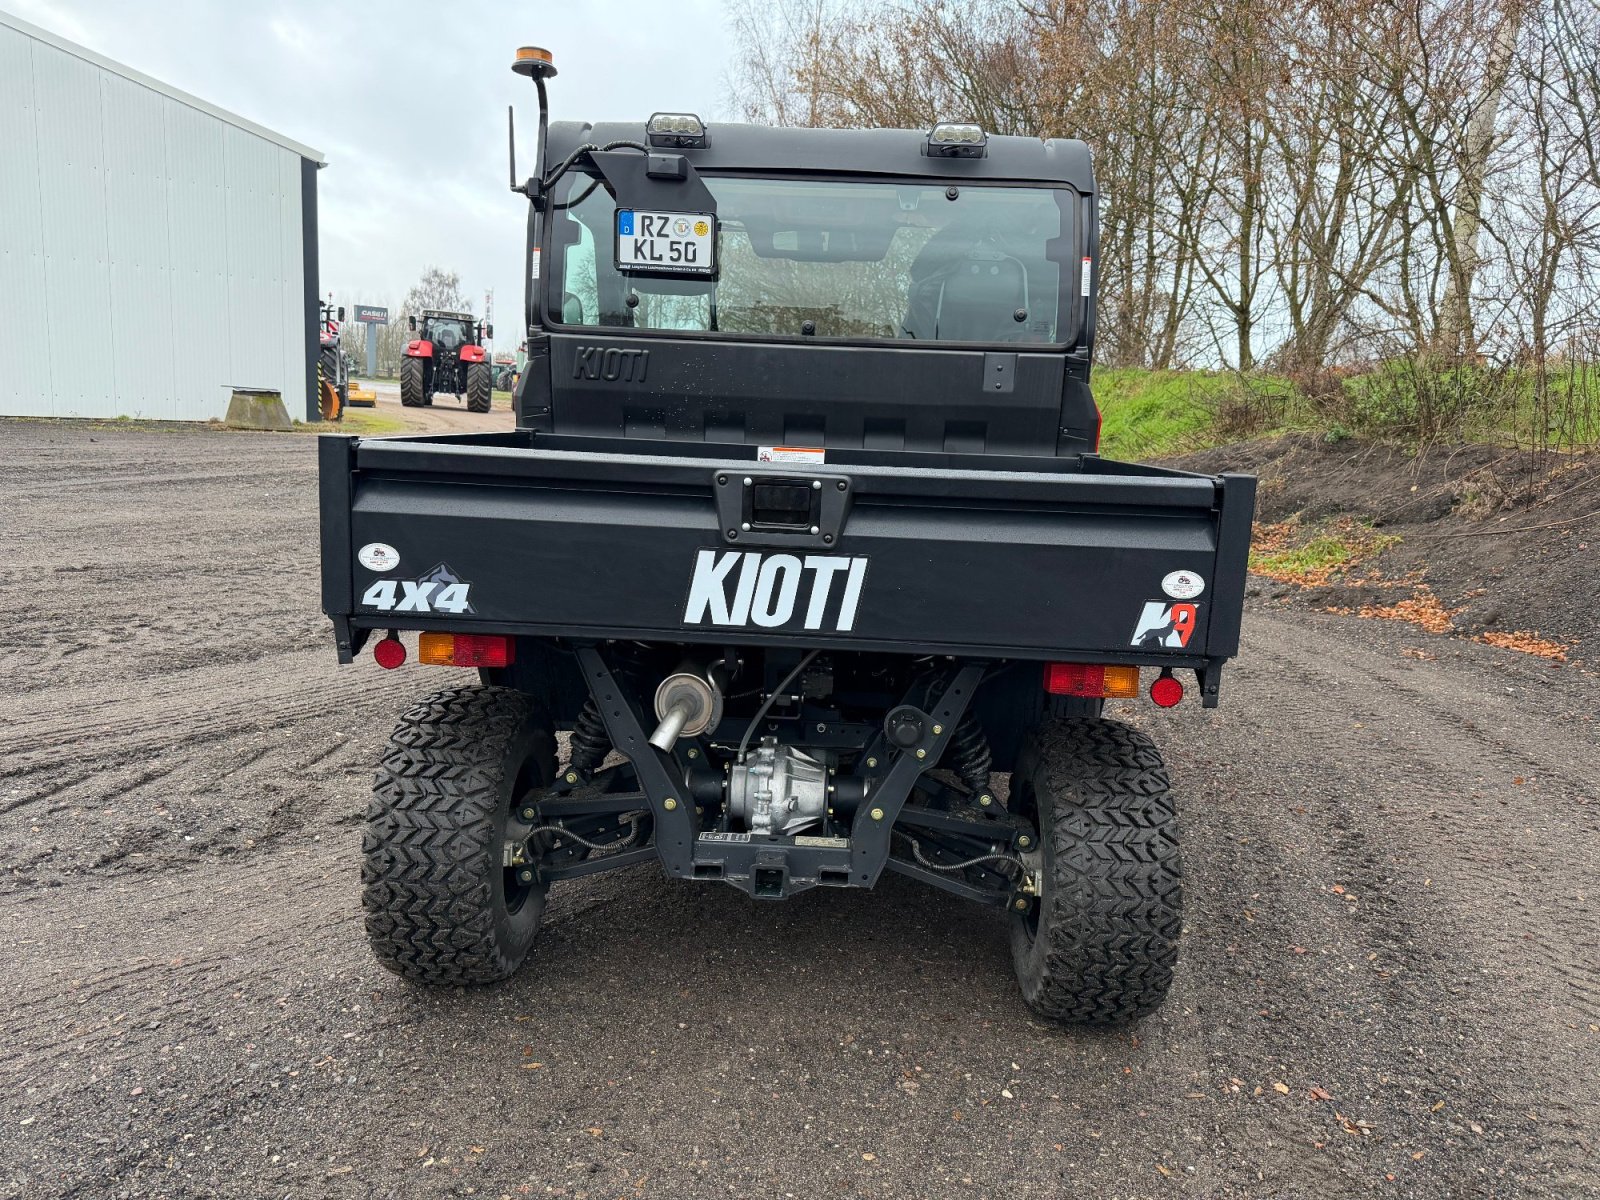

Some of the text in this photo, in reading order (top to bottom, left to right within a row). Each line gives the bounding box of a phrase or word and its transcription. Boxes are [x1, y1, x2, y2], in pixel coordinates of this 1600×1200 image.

[624, 226, 630, 234] D
[641, 215, 670, 238] RZ
[634, 238, 697, 263] KL 50
[573, 346, 650, 383] KIOTI
[683, 550, 868, 632] KIOTI
[1130, 601, 1201, 648] K9
